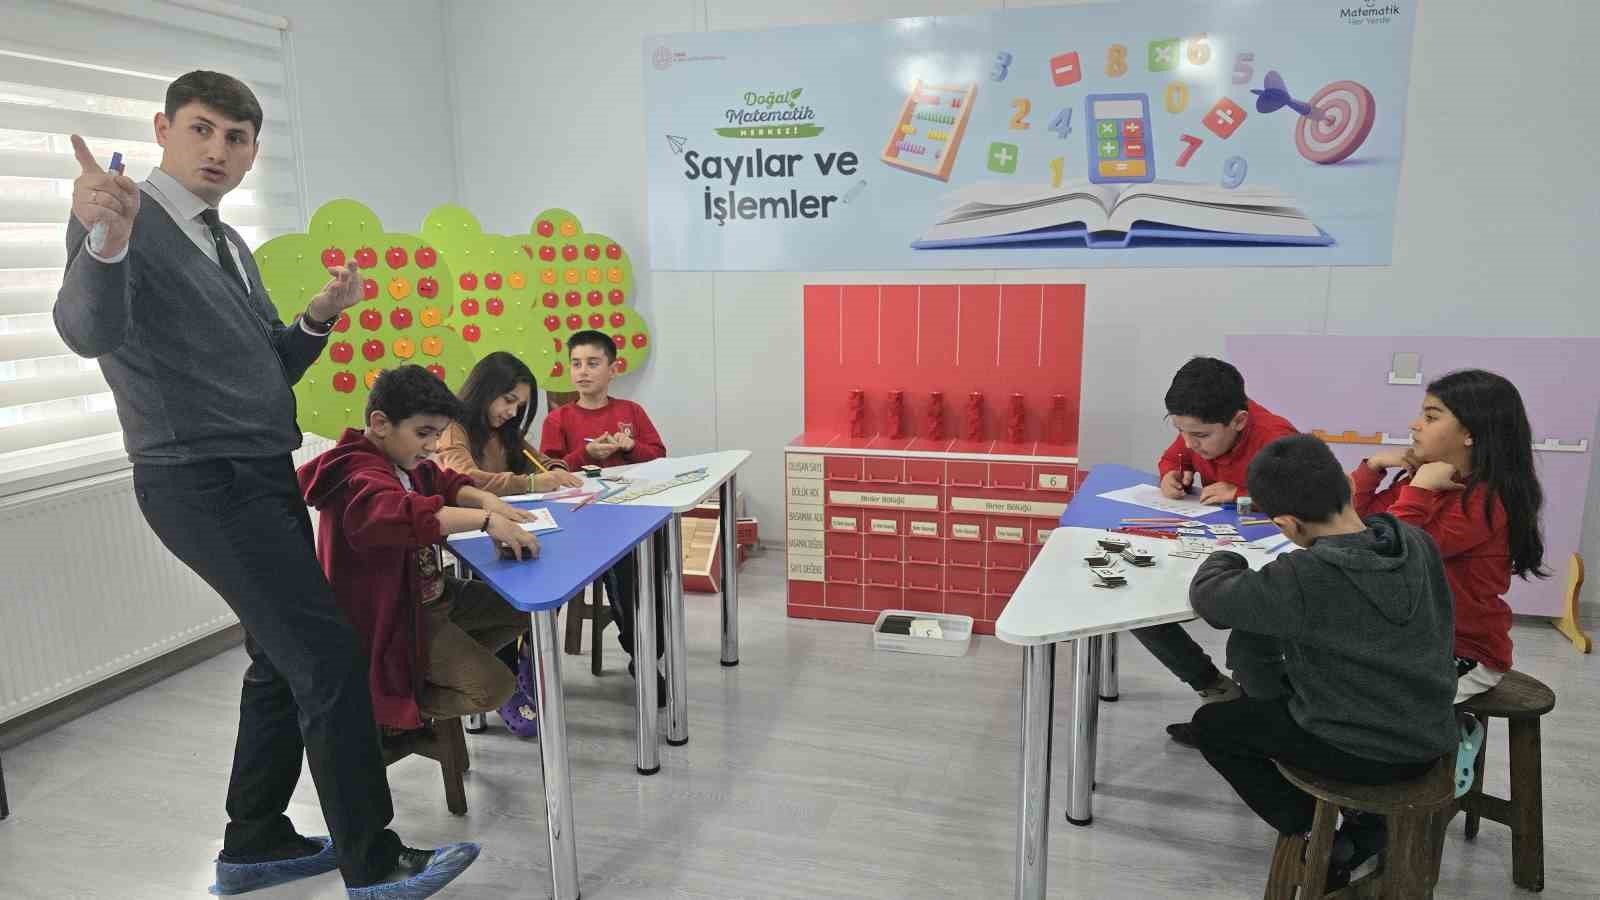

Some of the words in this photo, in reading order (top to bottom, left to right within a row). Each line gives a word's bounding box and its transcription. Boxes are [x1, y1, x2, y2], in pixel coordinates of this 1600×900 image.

[1340, 5, 1400, 18] Matematik
[991, 50, 1014, 82] 3
[1104, 43, 1128, 78] 8
[1232, 52, 1256, 85] 5
[725, 106, 815, 124] Matematik
[744, 90, 790, 109] Doğal
[1009, 97, 1032, 130] 2
[1048, 107, 1073, 140] 4
[684, 148, 804, 186] Sayılar
[814, 151, 858, 176] ve
[1175, 133, 1204, 168] 7
[1049, 156, 1065, 188] 1
[1221, 155, 1248, 189] 9
[704, 186, 838, 226] İşlemler
[1050, 477, 1057, 487] 6
